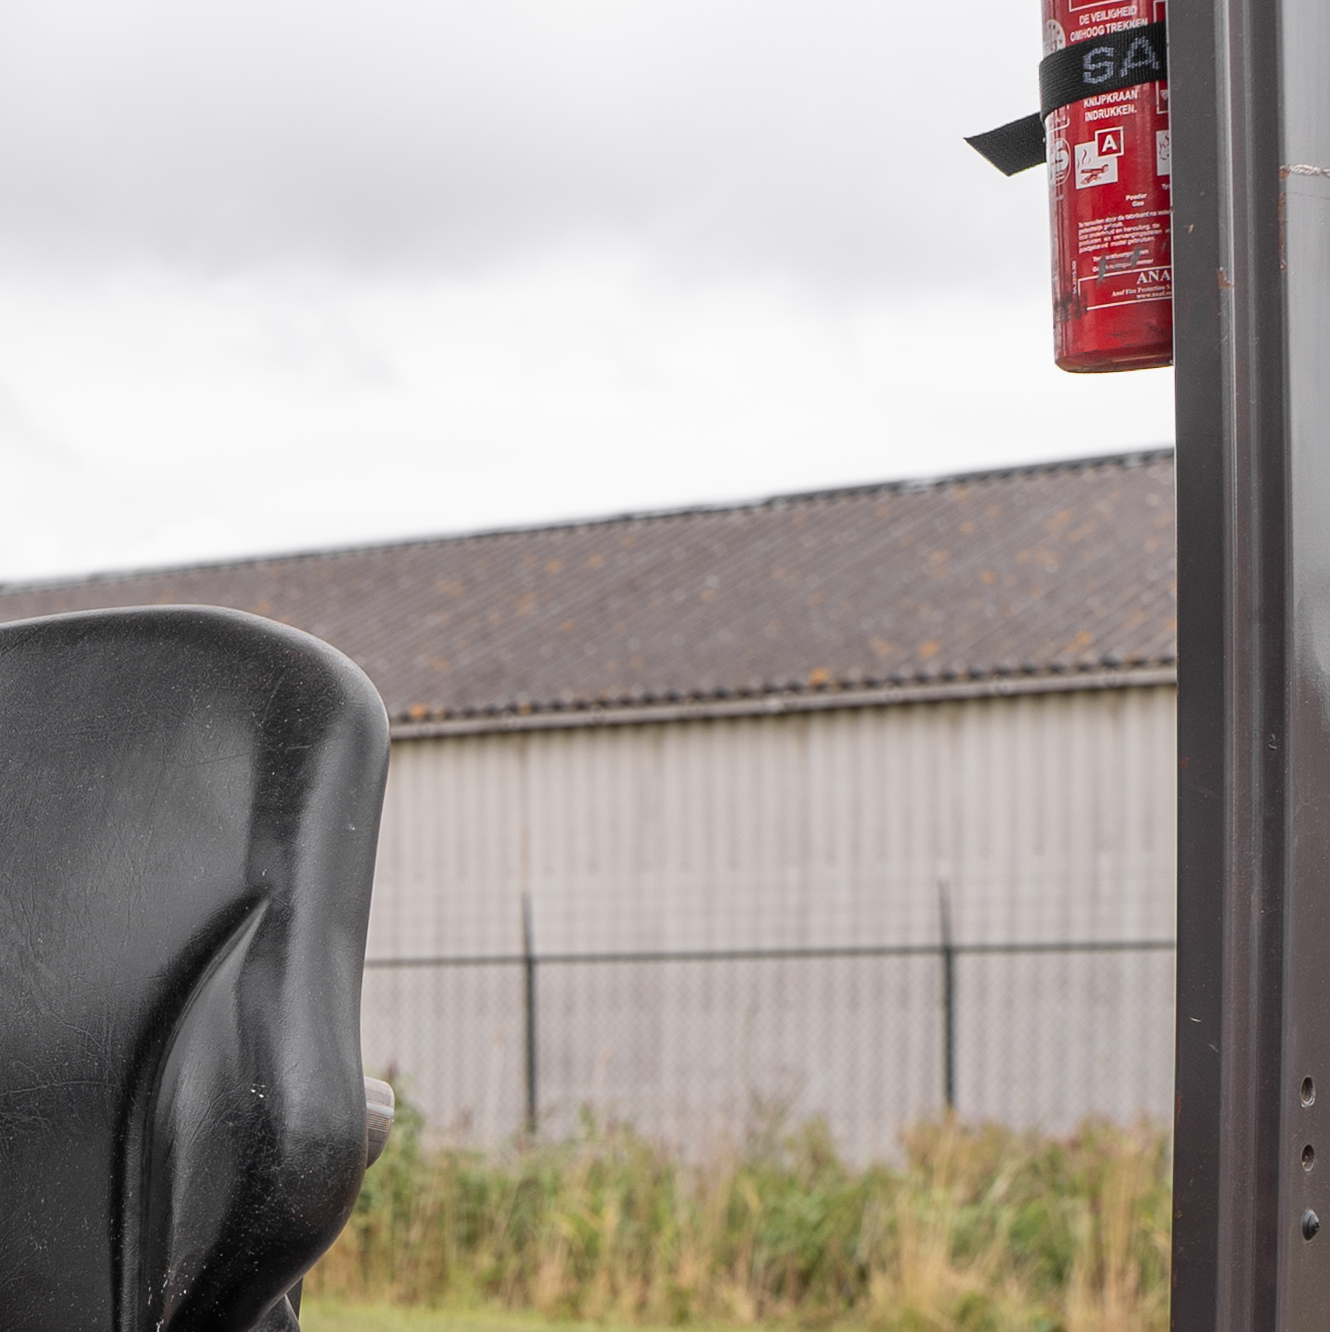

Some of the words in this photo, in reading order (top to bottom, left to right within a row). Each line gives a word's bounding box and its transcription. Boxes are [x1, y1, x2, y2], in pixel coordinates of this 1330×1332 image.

[1079, 14, 1090, 26] DE
[1091, 5, 1138, 23] VEILIGHEID
[1070, 26, 1105, 42] OMHOOG
[1106, 18, 1148, 34] TREKKEN
[1084, 88, 1139, 108] KNIJPKRAAN
[1084, 104, 1138, 122] INDRUKKEN.
[1101, 134, 1118, 153] A
